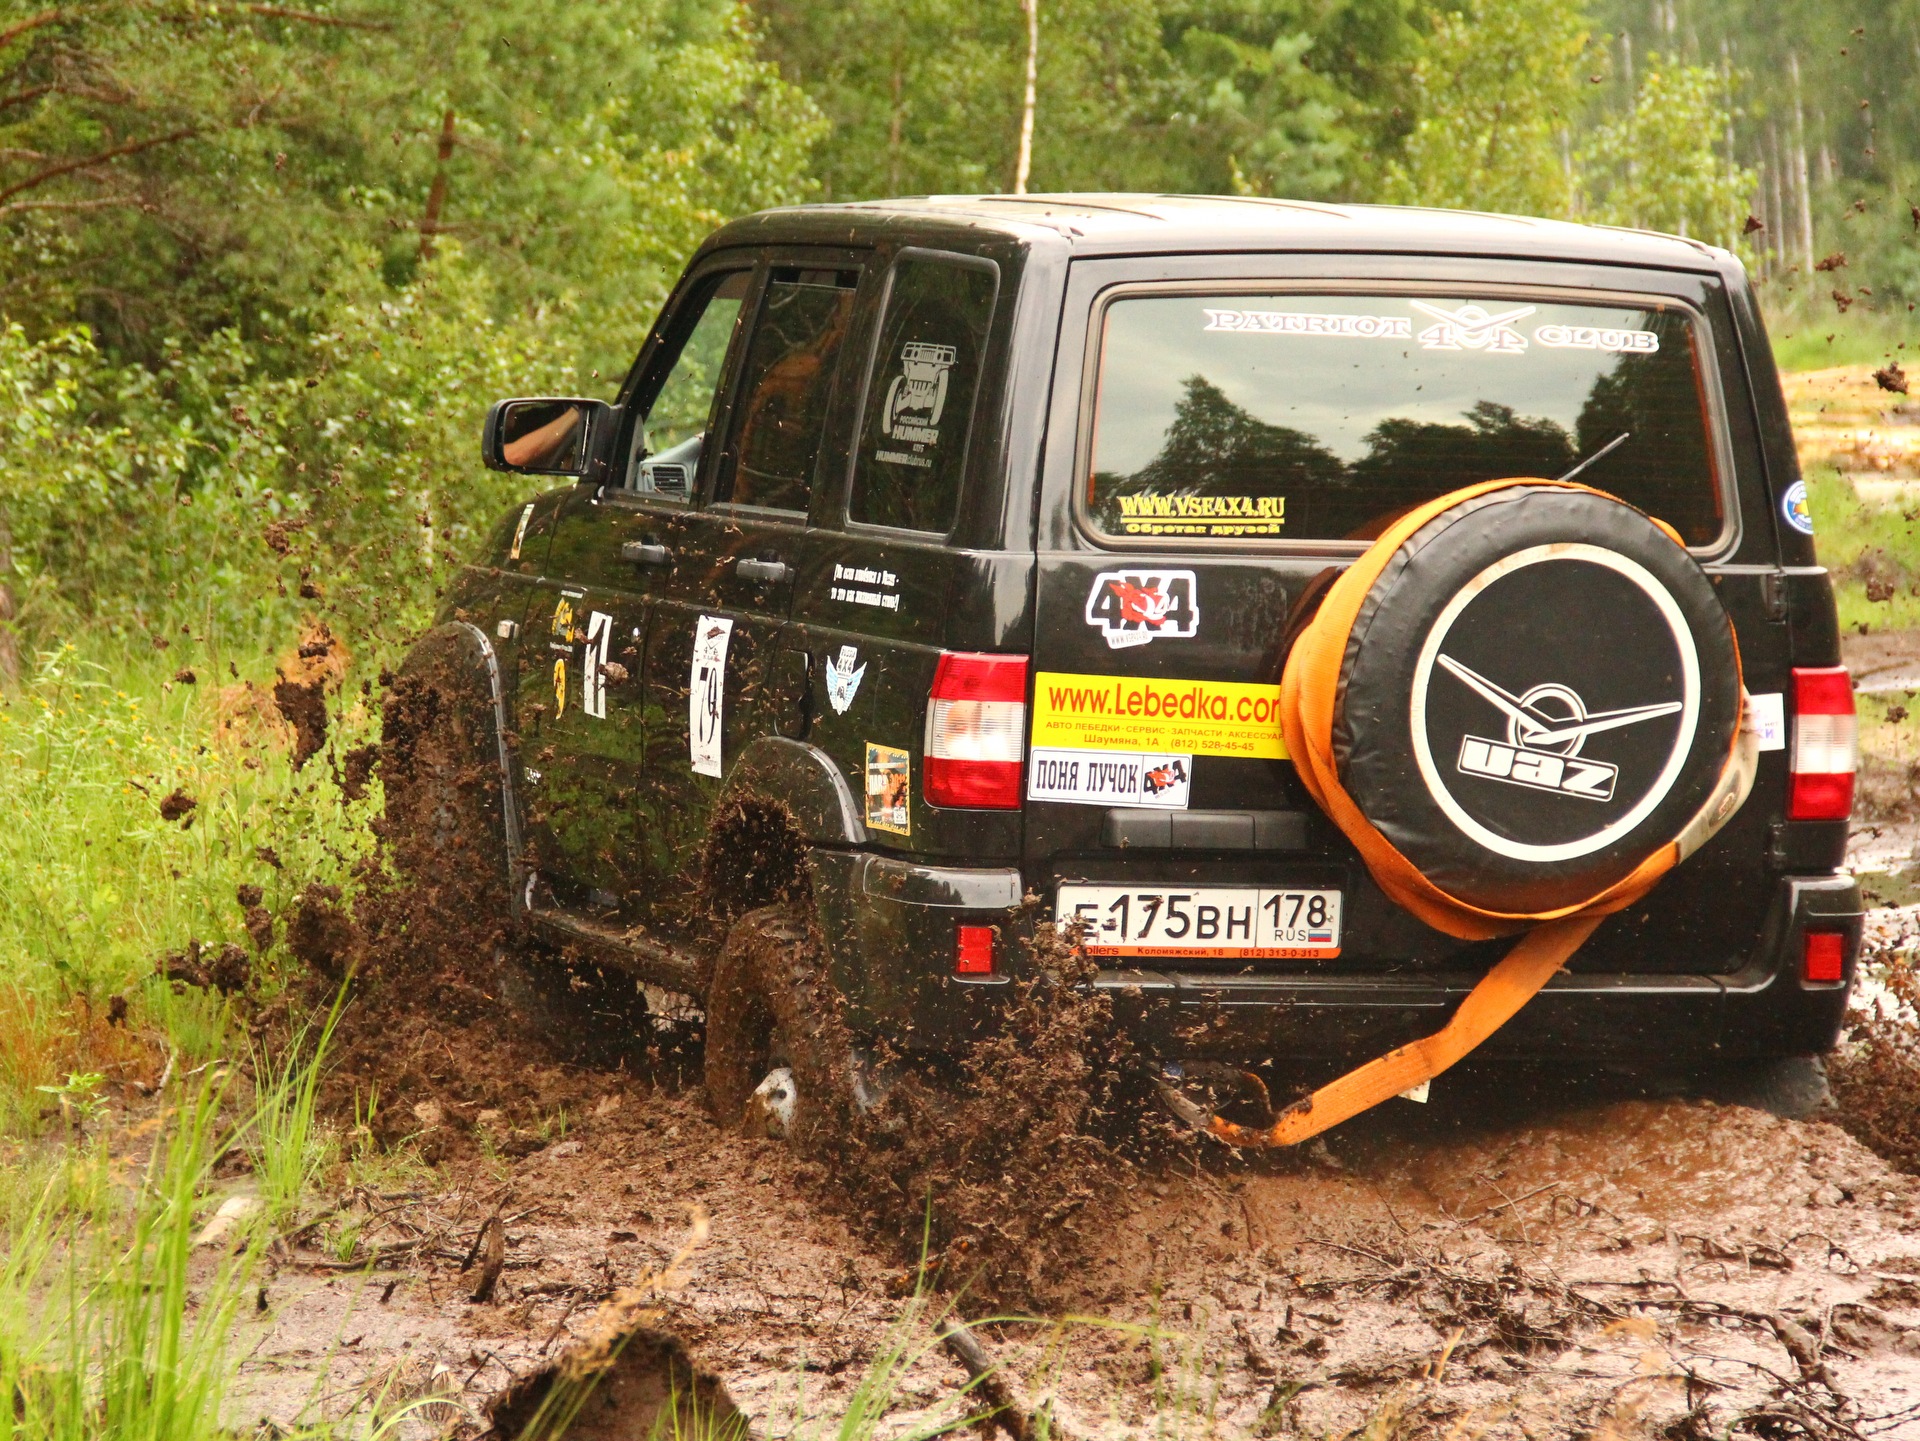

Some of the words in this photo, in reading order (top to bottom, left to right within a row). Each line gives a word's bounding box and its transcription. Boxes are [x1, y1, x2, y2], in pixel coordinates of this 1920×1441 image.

[1203, 308, 1412, 339] PATRIOT
[1535, 324, 1660, 353] CLUB
[892, 424, 939, 445] HUMMER
[1117, 490, 1285, 518] WWW.VSE4X4.RU
[1046, 721, 1072, 730] АВТО
[1074, 723, 1120, 732] ЛЕБЕДКИ
[1126, 726, 1166, 735] СЕРВИС
[1171, 728, 1222, 738] ЗАПЧАСТИ
[1084, 734, 1141, 748] Шаумяна,
[1170, 738, 1198, 750] (812)
[1202, 740, 1255, 751] 528-45-45
[1264, 895, 1327, 928] 178
[1274, 929, 1306, 941] RUS
[1078, 945, 1119, 957] ollers
[1137, 947, 1211, 958] Коломяжский,
[1212, 949, 1224, 957] 18
[1239, 948, 1266, 958] (812)
[1269, 948, 1320, 958] 313-0-313
